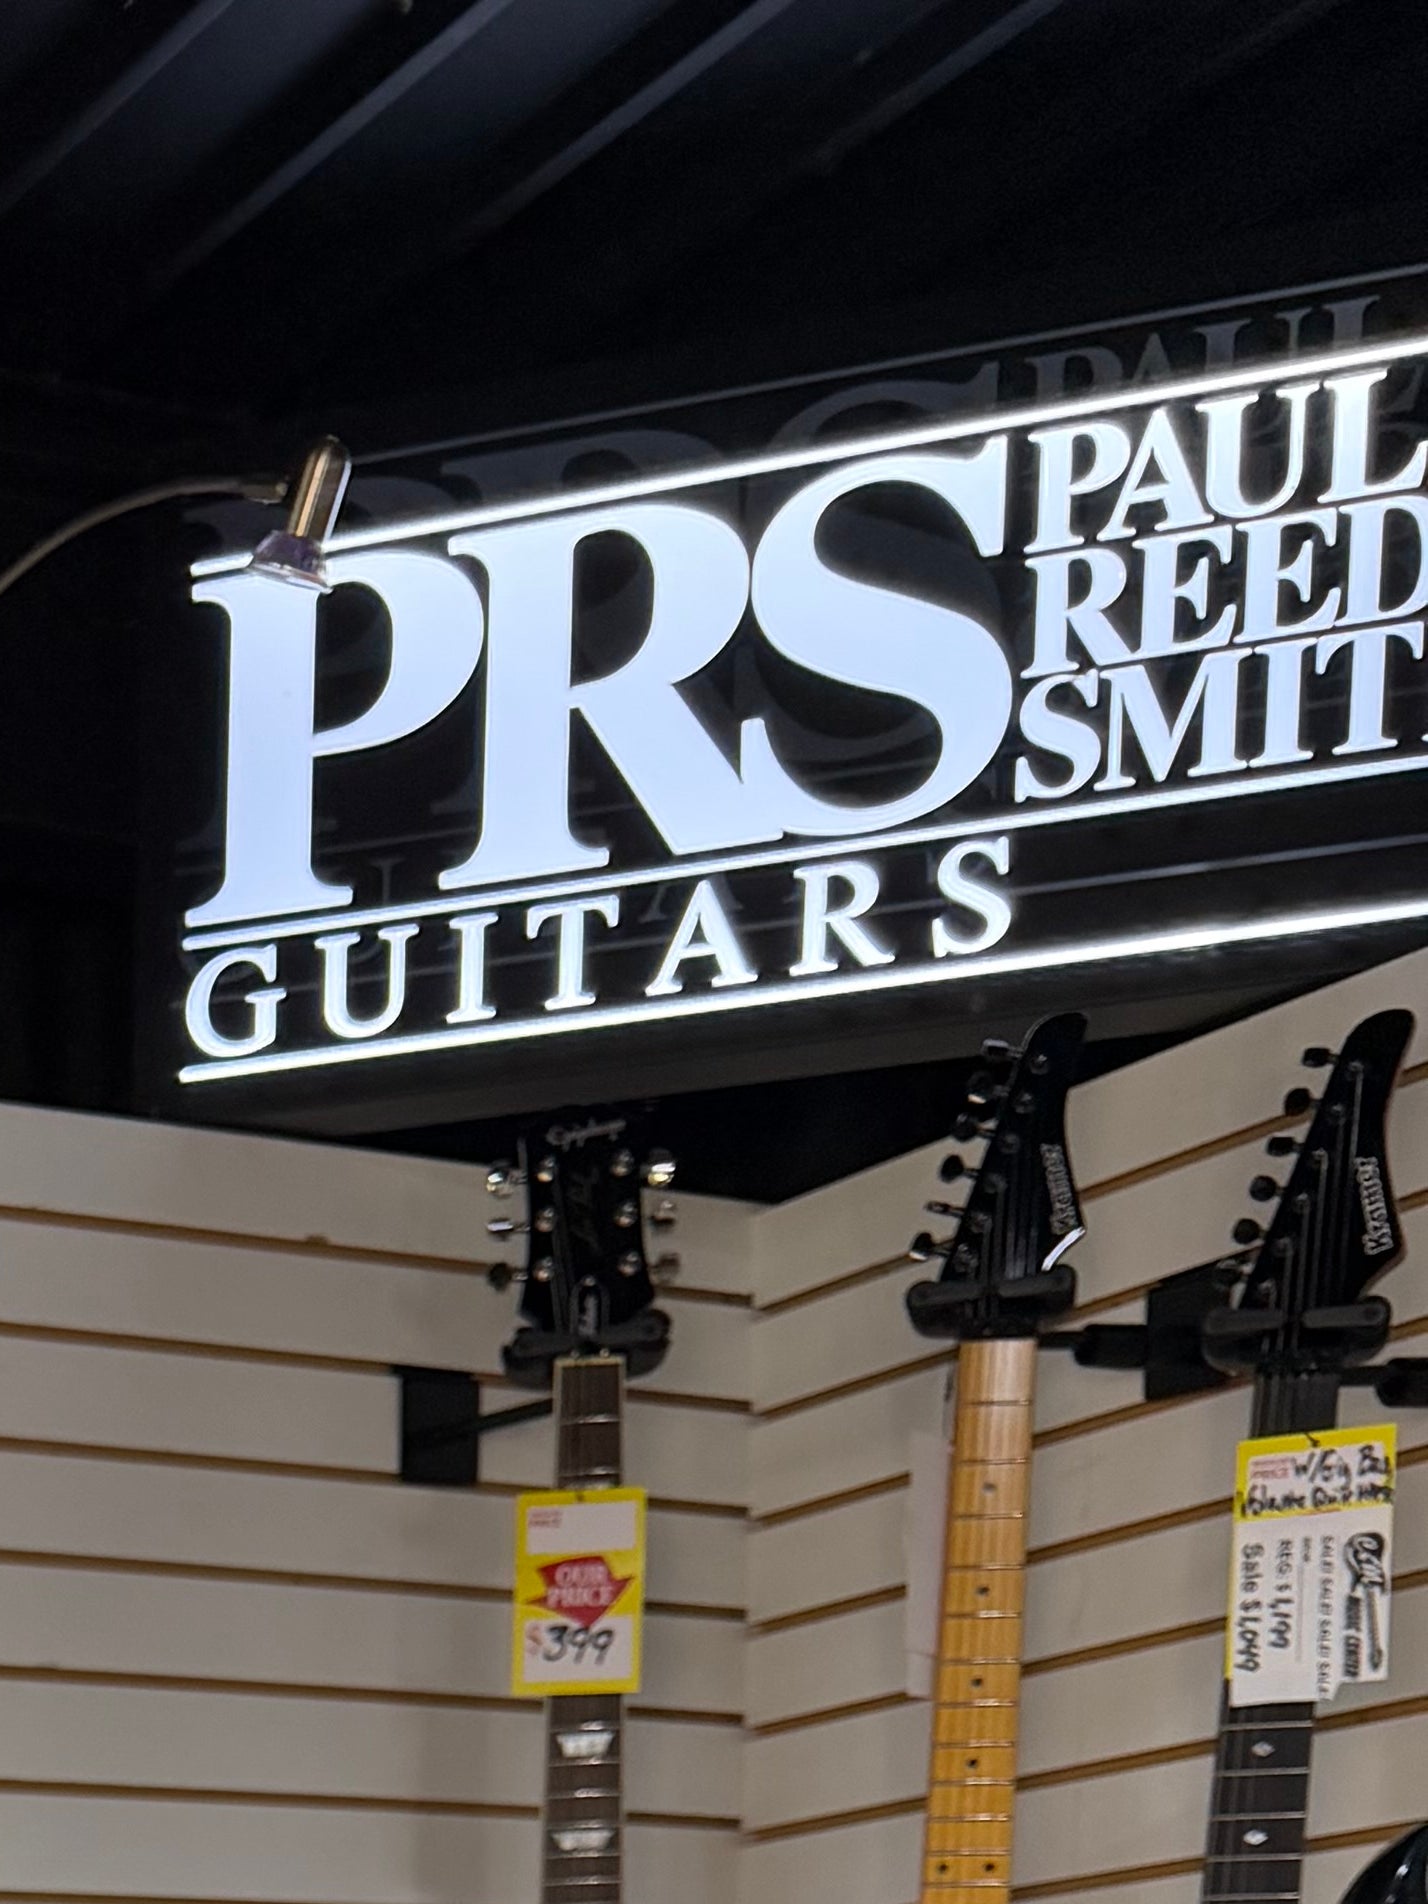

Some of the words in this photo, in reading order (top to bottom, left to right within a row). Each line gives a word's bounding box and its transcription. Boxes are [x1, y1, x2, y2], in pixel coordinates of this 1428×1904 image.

[1023, 366, 1428, 556] PAUL
[182, 432, 1015, 931] PRS
[1023, 494, 1428, 680] REED
[1013, 614, 1428, 805] SMIT
[181, 834, 1015, 1062] GUITARS
[546, 1584, 615, 1608] PRICE
[552, 1563, 609, 1587] OUR
